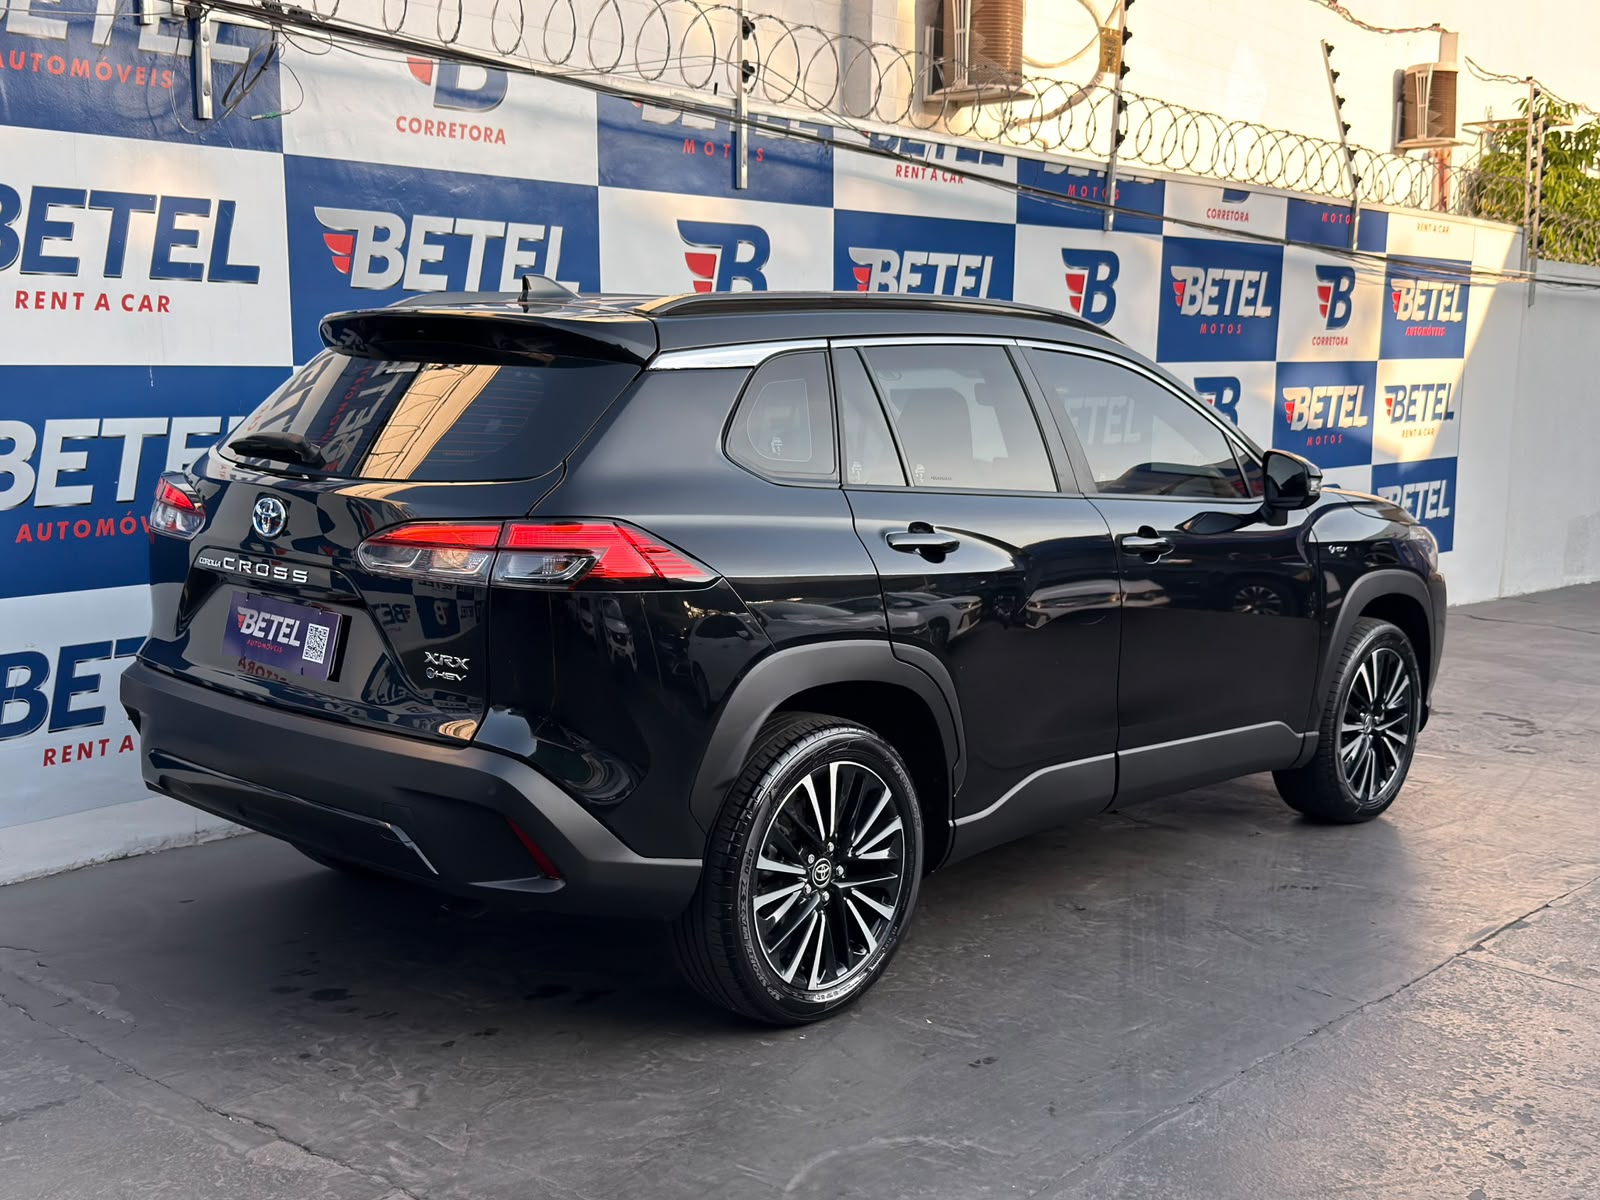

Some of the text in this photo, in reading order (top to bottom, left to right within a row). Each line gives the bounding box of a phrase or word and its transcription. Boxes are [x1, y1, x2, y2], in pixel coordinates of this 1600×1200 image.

[0, 49, 173, 88] UTOMÓVEIS
[396, 115, 506, 145] CORRETORA
[682, 138, 764, 163] MOTS
[895, 164, 927, 180] RENT
[930, 168, 938, 182] A
[1206, 208, 1249, 223] CORRETORA
[1321, 212, 1354, 225] MOTO
[314, 206, 580, 292] BETEL
[1061, 247, 1120, 326] B
[1170, 265, 1272, 318] BETEL
[1315, 264, 1356, 330] B
[1391, 278, 1464, 322] BETEL
[15, 290, 171, 312] RENT A CAR
[1200, 323, 1242, 335] MOTOS
[1311, 336, 1349, 346] CORRETORA
[1405, 325, 1446, 337] AUTOMÓVEIS
[1282, 384, 1369, 431] BETEL
[1383, 383, 1455, 424] BETEL
[1307, 434, 1343, 447] MOTOS
[199, 557, 308, 584] COROLLA CROSS
[237, 606, 301, 648] BETEL
[424, 651, 470, 670] XRX
[43, 735, 135, 767] RENT A
